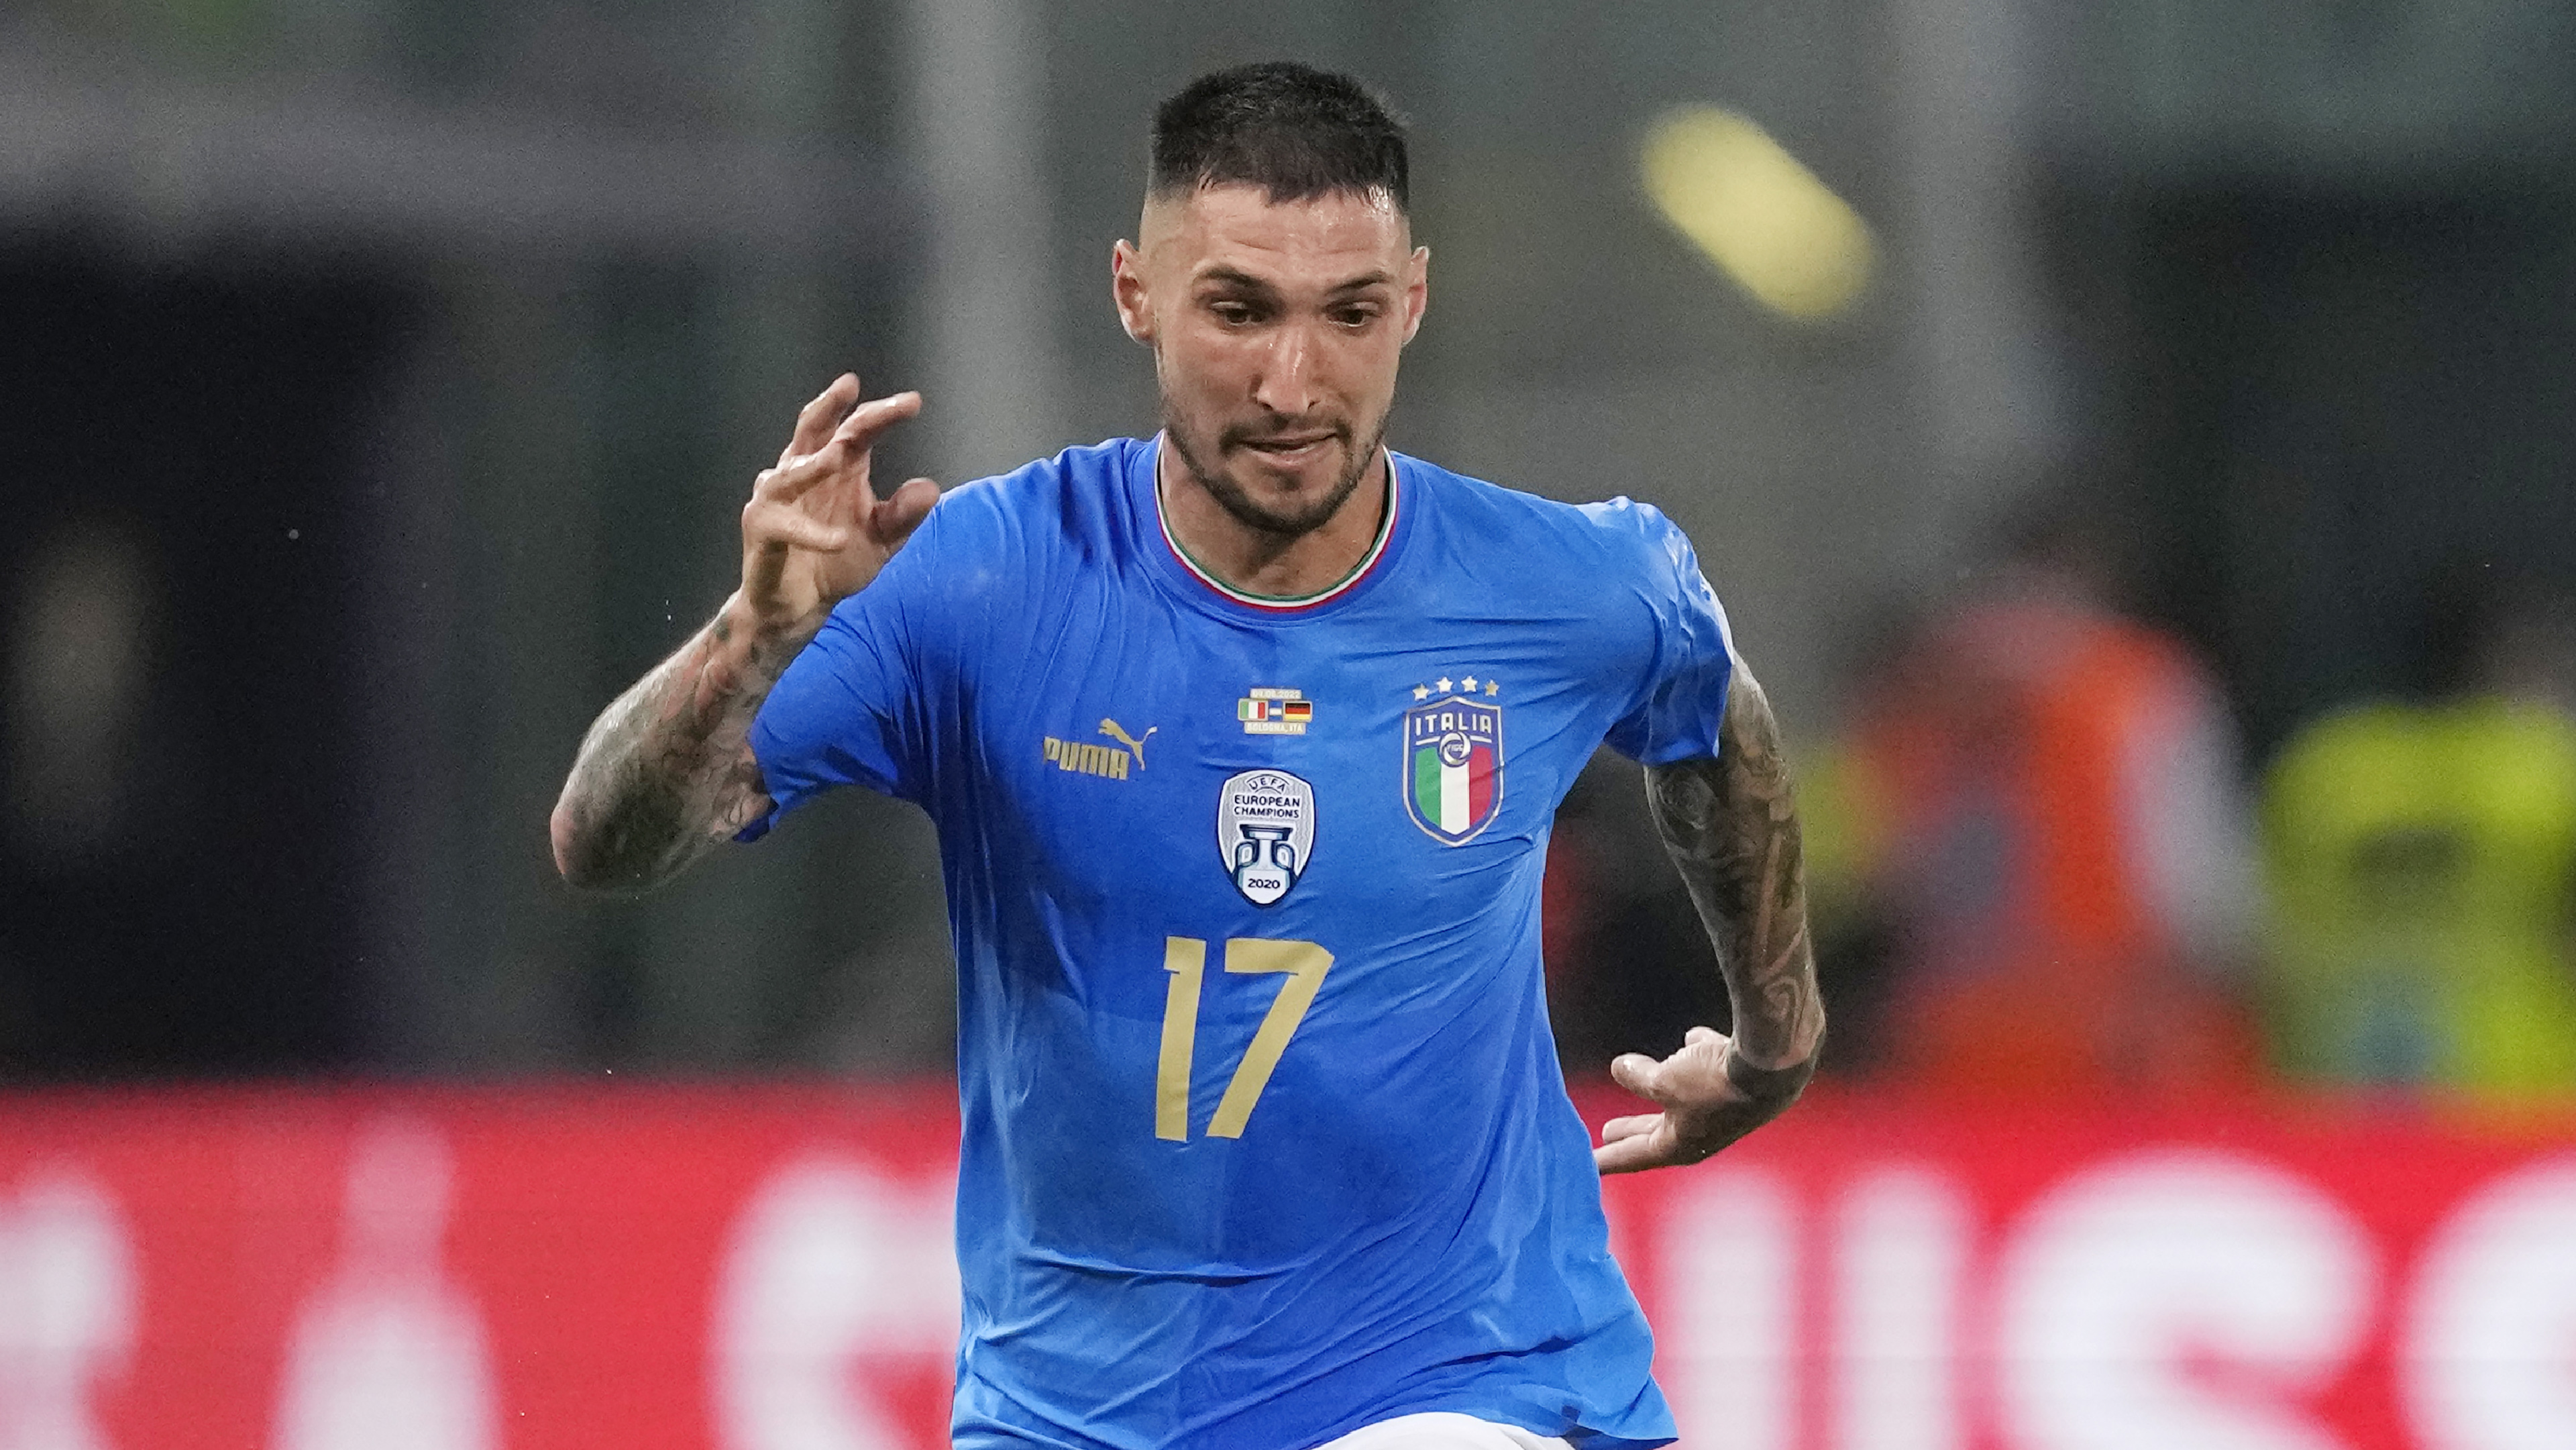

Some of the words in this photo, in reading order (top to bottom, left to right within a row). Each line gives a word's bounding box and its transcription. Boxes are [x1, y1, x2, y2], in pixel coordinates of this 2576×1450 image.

[1415, 713, 1493, 736] ITALIA
[1043, 736, 1130, 780] PUMA
[1248, 777, 1286, 792] UEFA
[1234, 794, 1300, 807] EUROPEAN
[1234, 806, 1299, 819] CHAMPIONS
[1248, 878, 1281, 889] 2020
[1155, 936, 1335, 1142] 17
